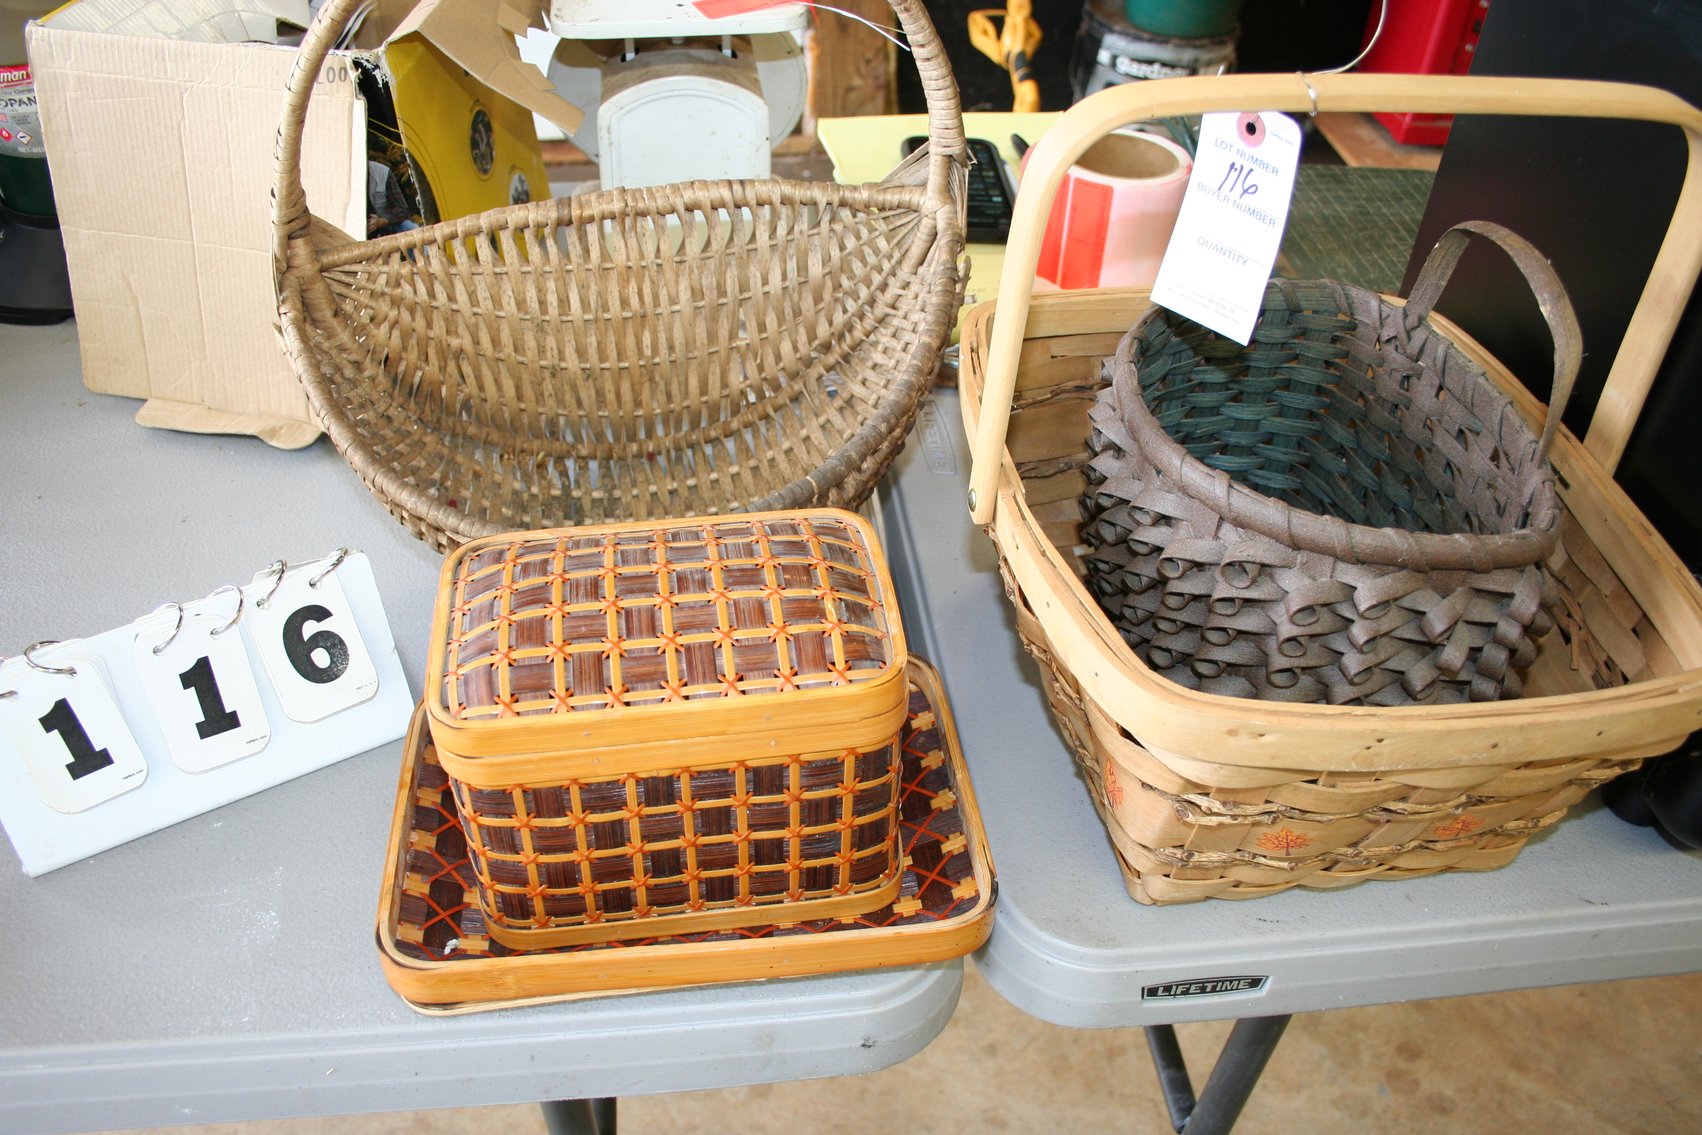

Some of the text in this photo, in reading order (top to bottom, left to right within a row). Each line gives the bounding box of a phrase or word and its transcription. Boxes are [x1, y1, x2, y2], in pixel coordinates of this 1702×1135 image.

[0, 70, 27, 83] man
[317, 66, 348, 84] 00
[1214, 137, 1280, 177] LOT NUMBER
[1196, 181, 1277, 229] BUYER NUMBER
[1196, 235, 1249, 268] QUANTITY
[38, 604, 350, 781] 1 1 6
[1156, 979, 1252, 997] LIFETIME
